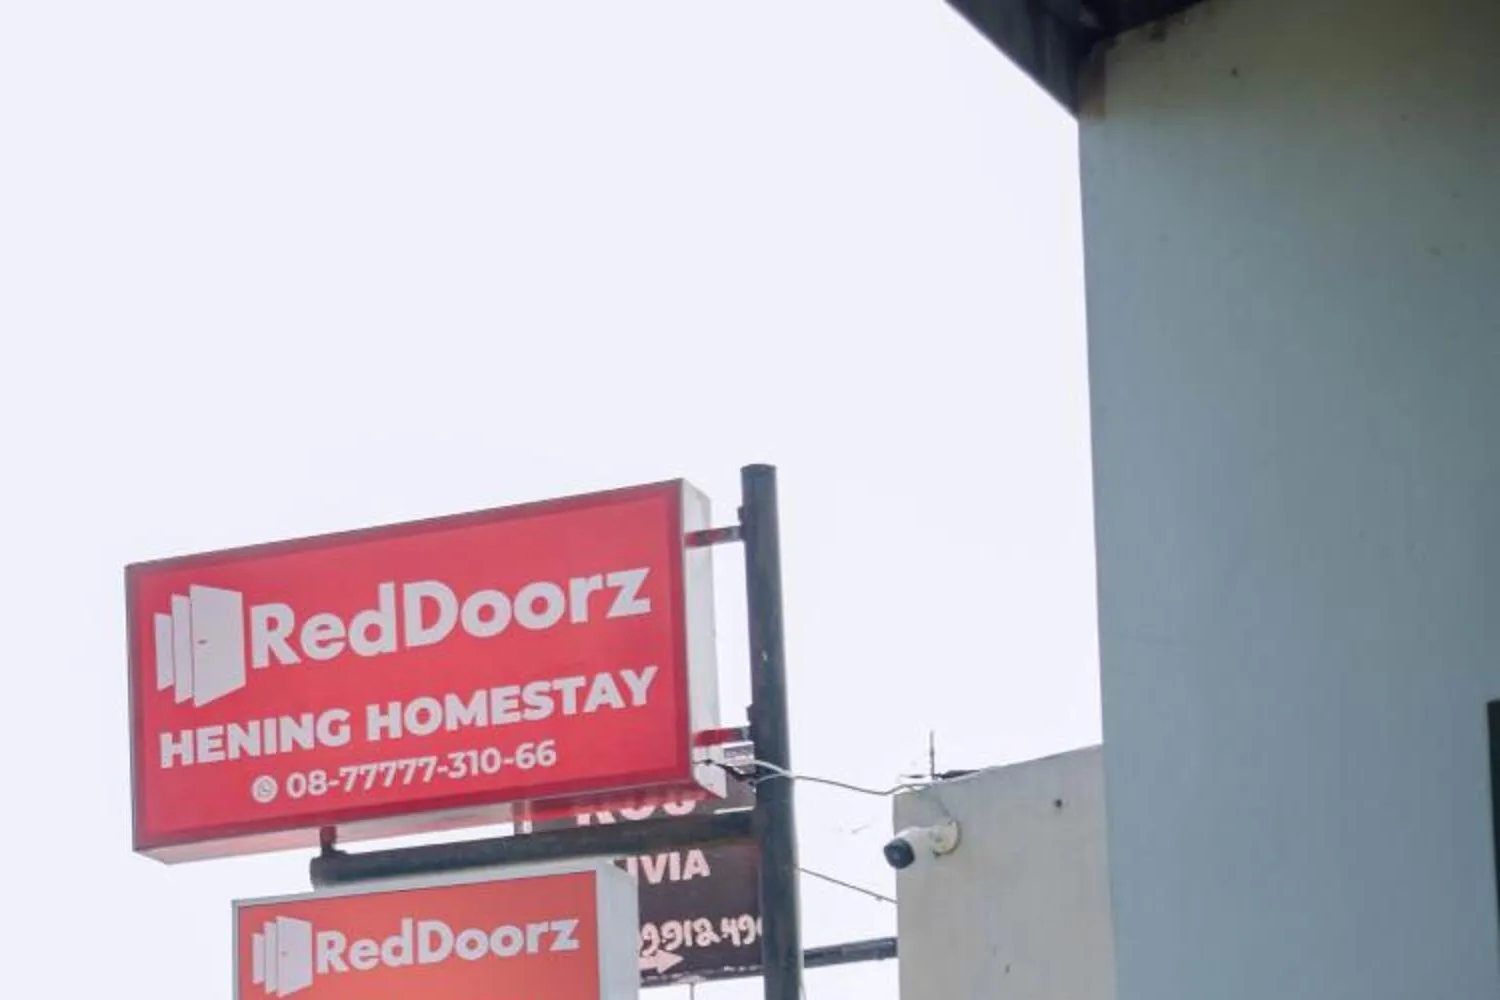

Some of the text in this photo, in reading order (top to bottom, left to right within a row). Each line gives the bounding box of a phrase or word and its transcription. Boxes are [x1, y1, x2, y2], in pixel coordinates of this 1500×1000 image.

[250, 567, 651, 669] RedDoorz
[159, 665, 658, 769] HENING HOMESTAY
[285, 739, 557, 799] 08-77777-310-66
[315, 917, 580, 975] RedDoorz
